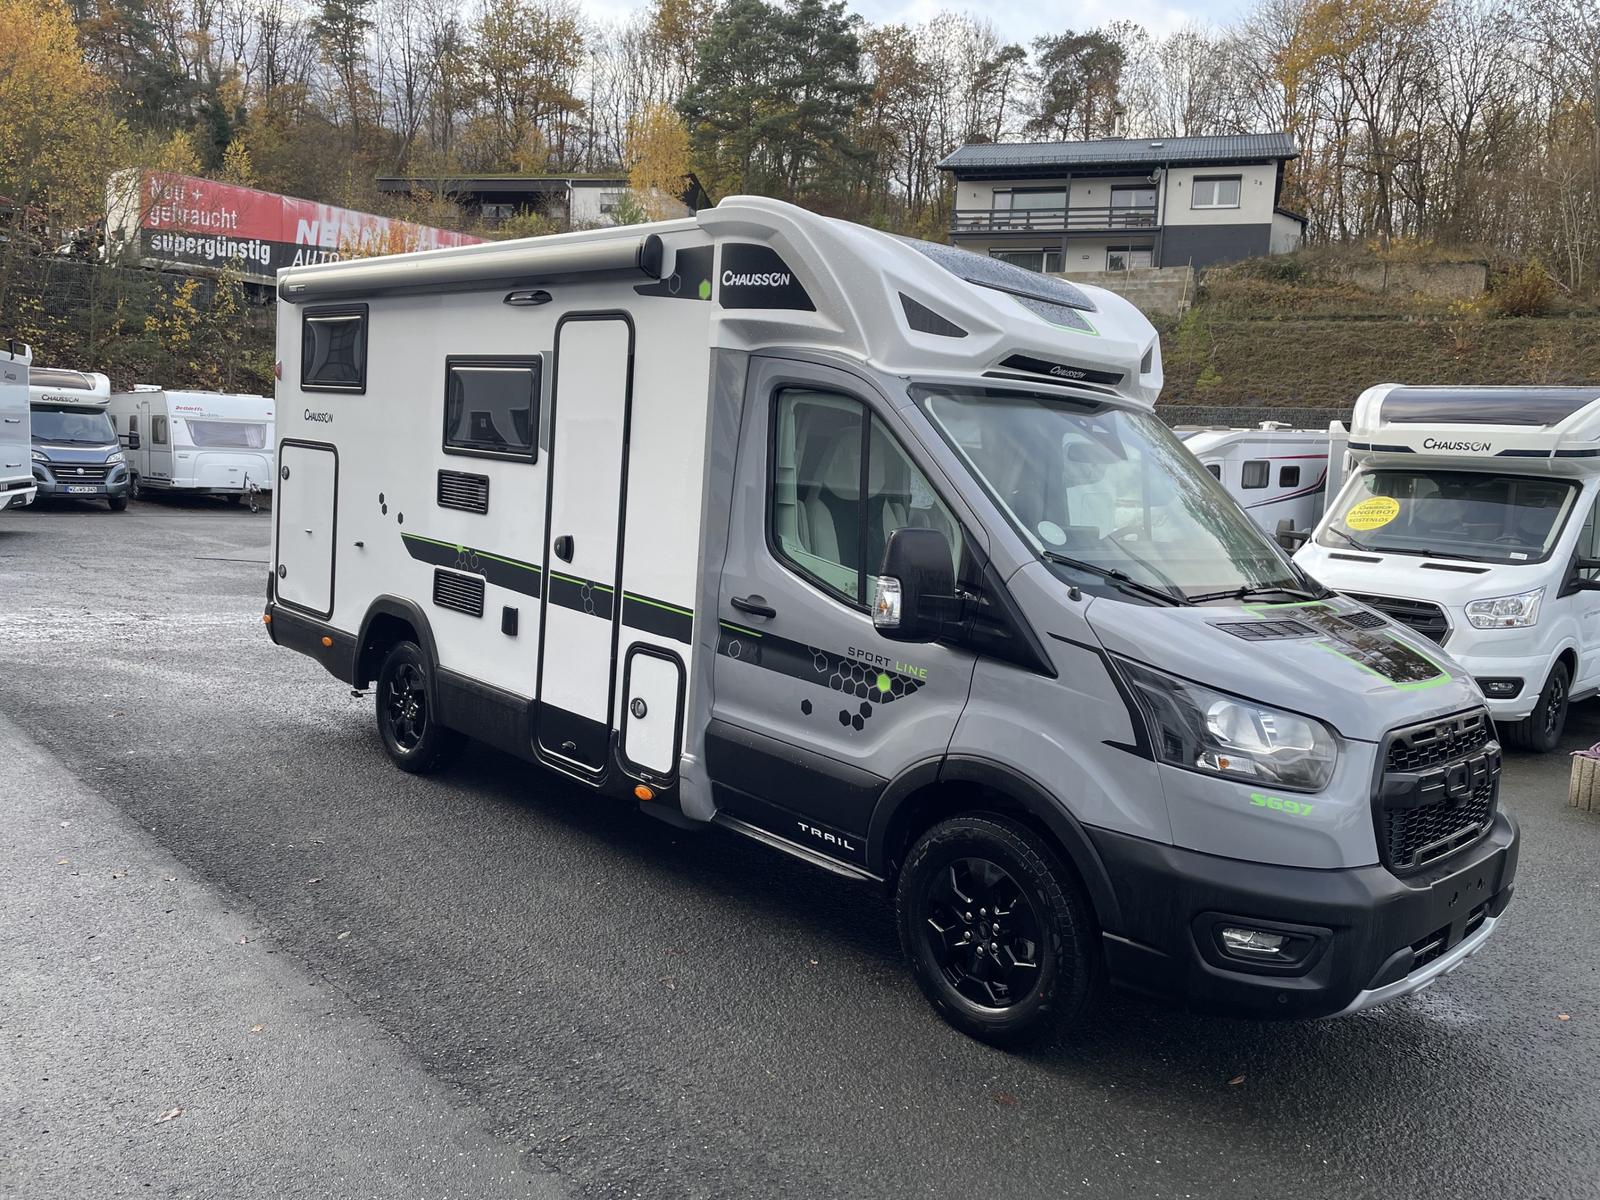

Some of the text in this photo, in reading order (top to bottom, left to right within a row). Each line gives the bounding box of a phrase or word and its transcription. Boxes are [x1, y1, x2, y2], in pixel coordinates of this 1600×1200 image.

[150, 202, 238, 229] gebraucht
[150, 232, 271, 264] supergünstig
[722, 270, 791, 287] CHAUSSON
[304, 408, 334, 423] CHAUSSON
[1422, 438, 1492, 452] CHAUSSON
[848, 647, 928, 679] SPORT LINE
[1249, 793, 1314, 817] S697
[797, 822, 855, 851] TRAIL
